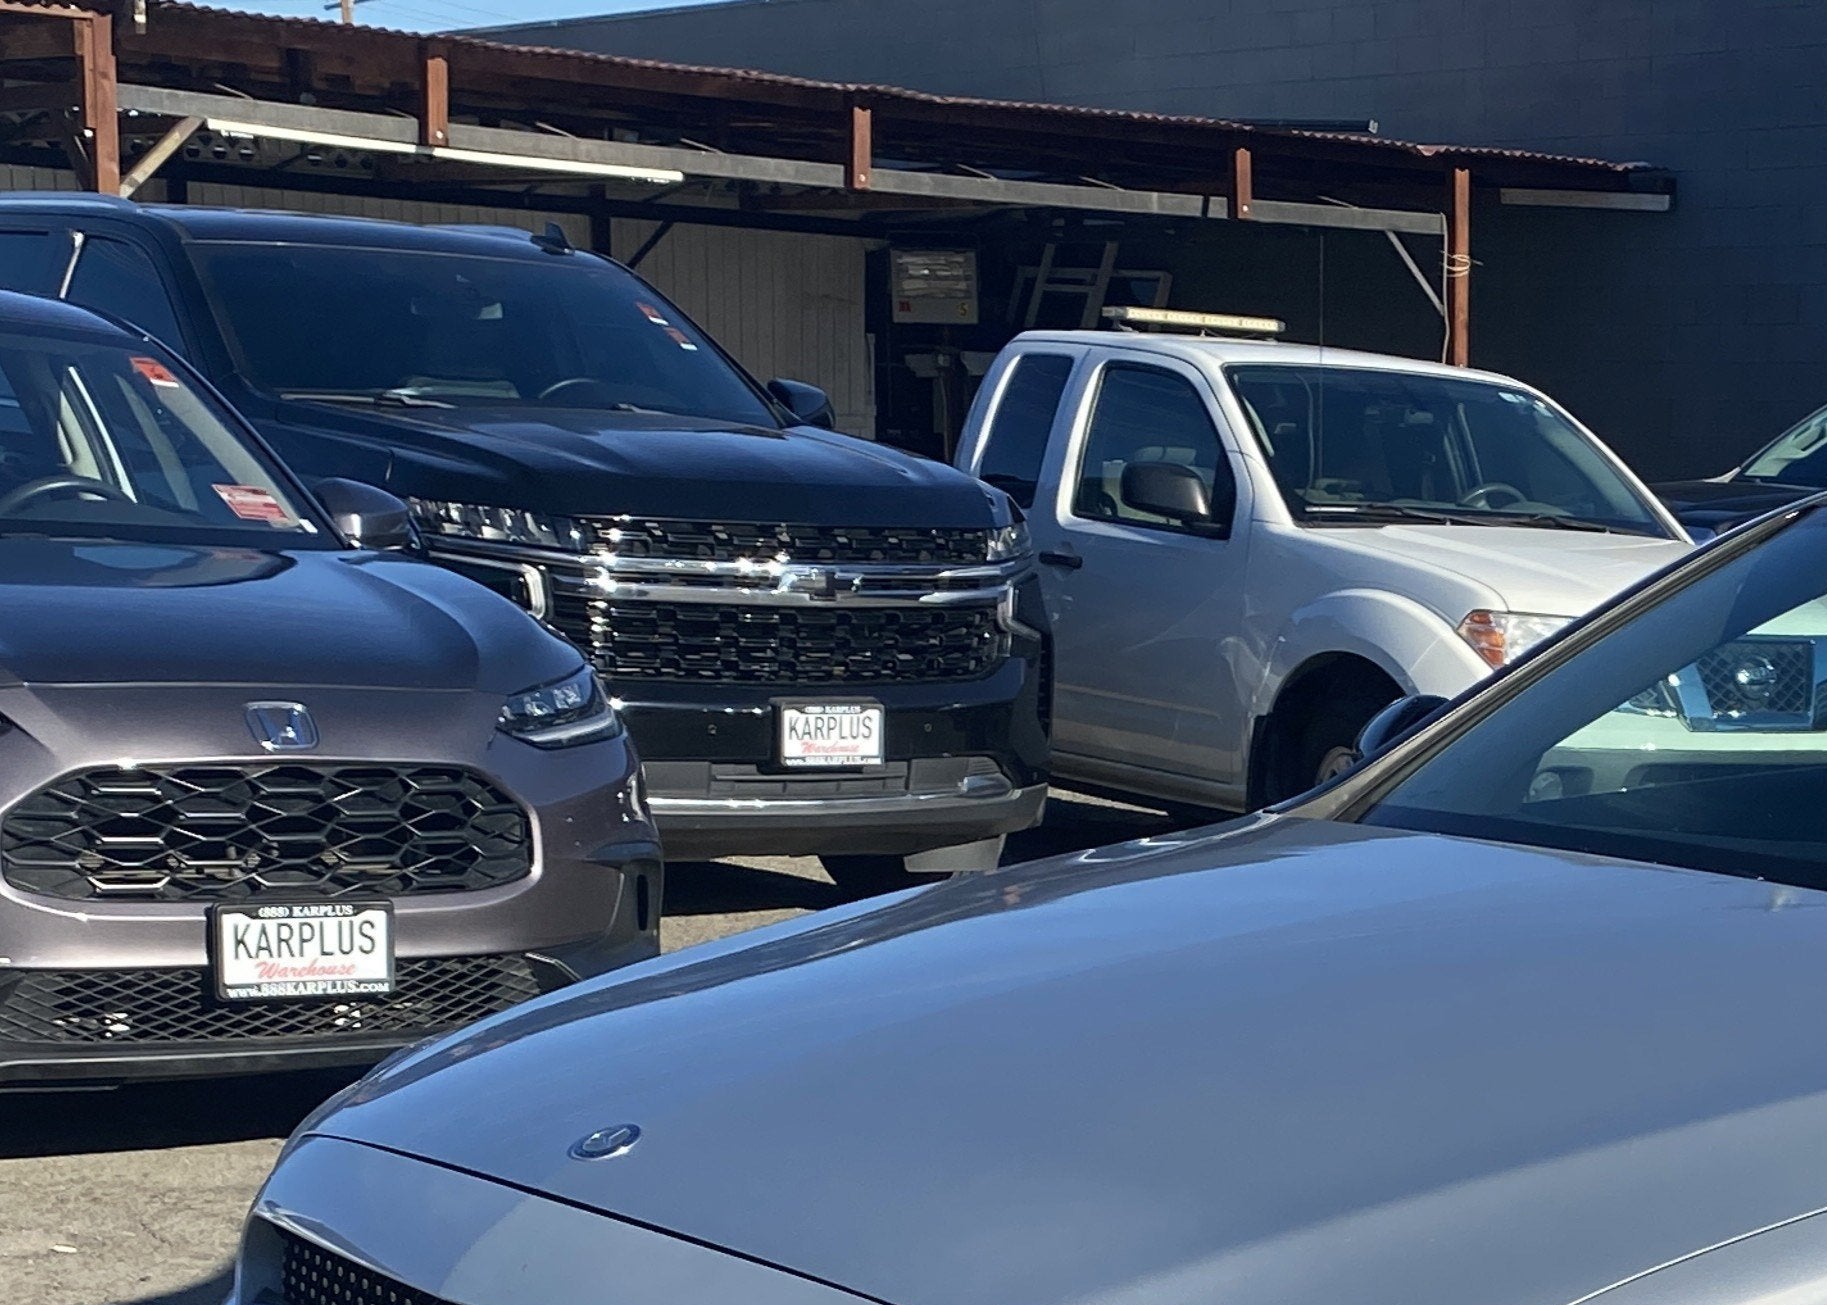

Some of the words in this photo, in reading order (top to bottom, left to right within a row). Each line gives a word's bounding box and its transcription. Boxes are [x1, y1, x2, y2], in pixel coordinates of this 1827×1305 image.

[788, 715, 873, 741] KARPLUS
[292, 904, 354, 917] KARPLUS
[233, 919, 376, 960] KARPLUS
[254, 957, 356, 979] Warehouse
